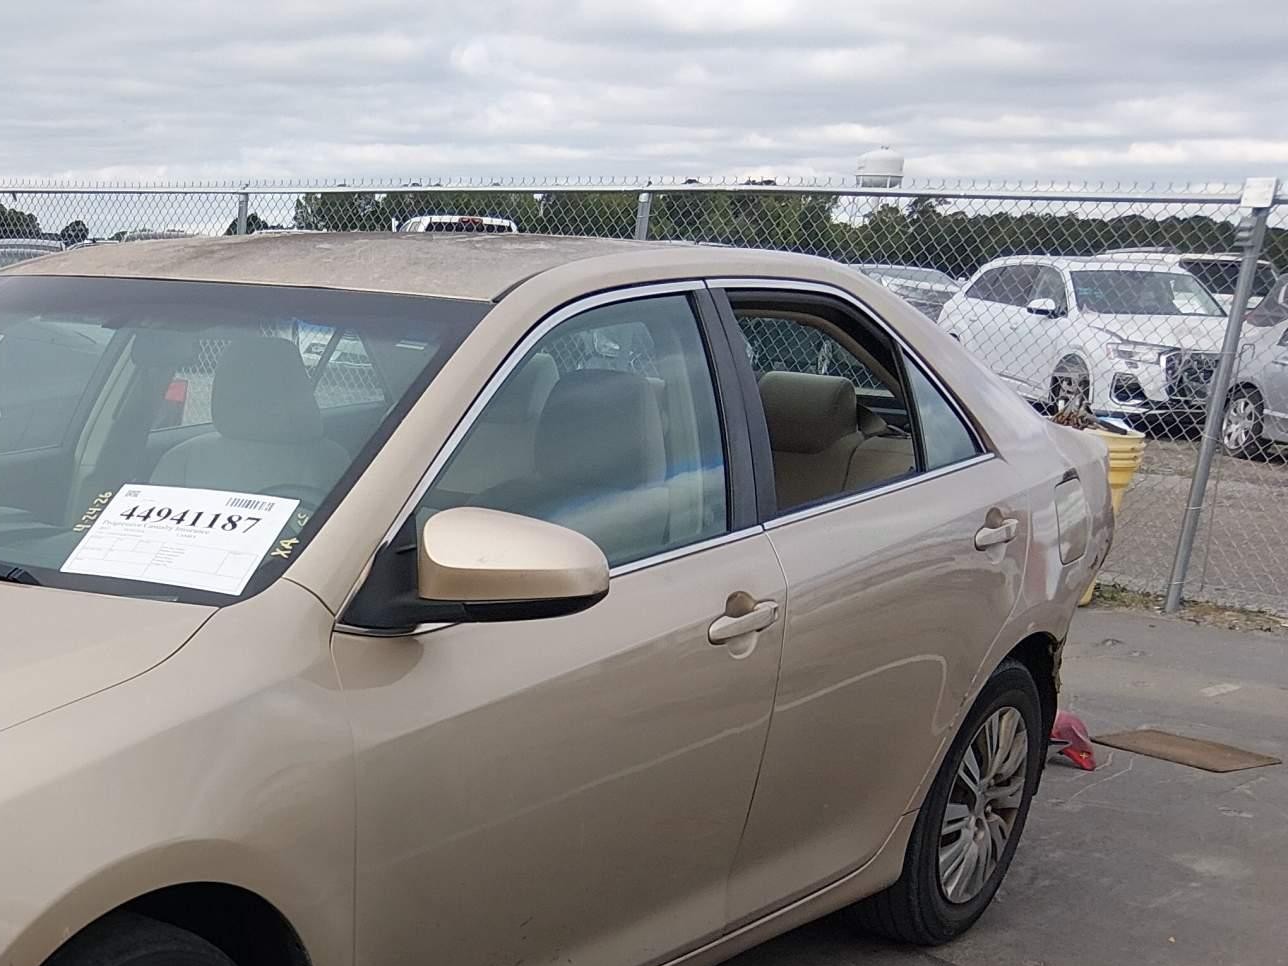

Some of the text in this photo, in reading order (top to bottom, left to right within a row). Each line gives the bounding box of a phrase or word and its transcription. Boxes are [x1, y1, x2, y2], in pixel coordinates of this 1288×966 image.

[73, 491, 112, 531] 4-24-26
[119, 504, 262, 534] 44941187
[270, 537, 300, 559] XA
